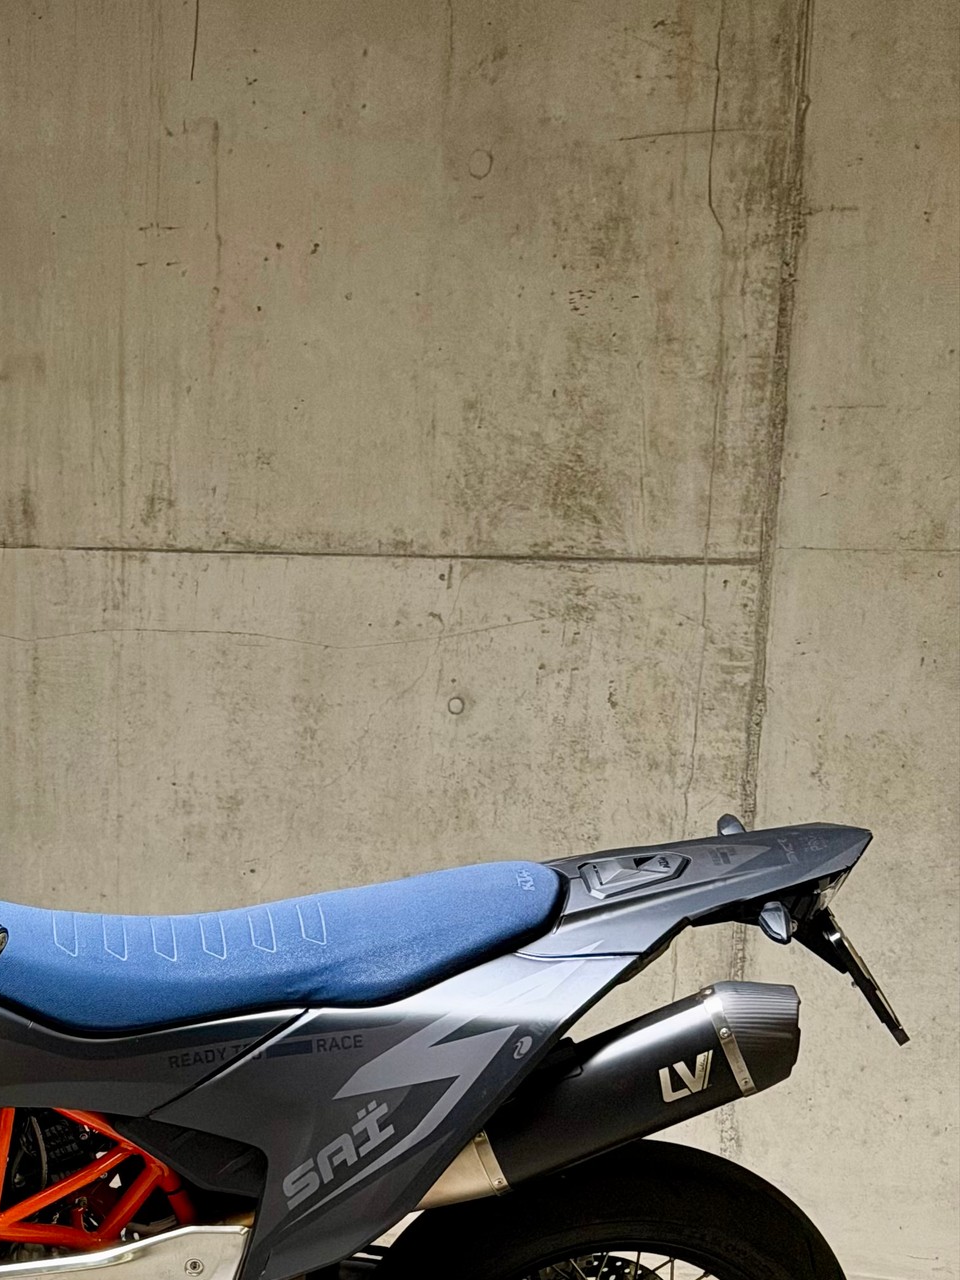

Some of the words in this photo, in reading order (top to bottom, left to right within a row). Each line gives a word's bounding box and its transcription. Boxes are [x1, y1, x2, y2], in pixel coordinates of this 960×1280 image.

[168, 1047, 227, 1069] READY
[316, 1034, 365, 1053] RACE
[658, 1049, 714, 1103] LV
[282, 1100, 395, 1211] SAÏ
